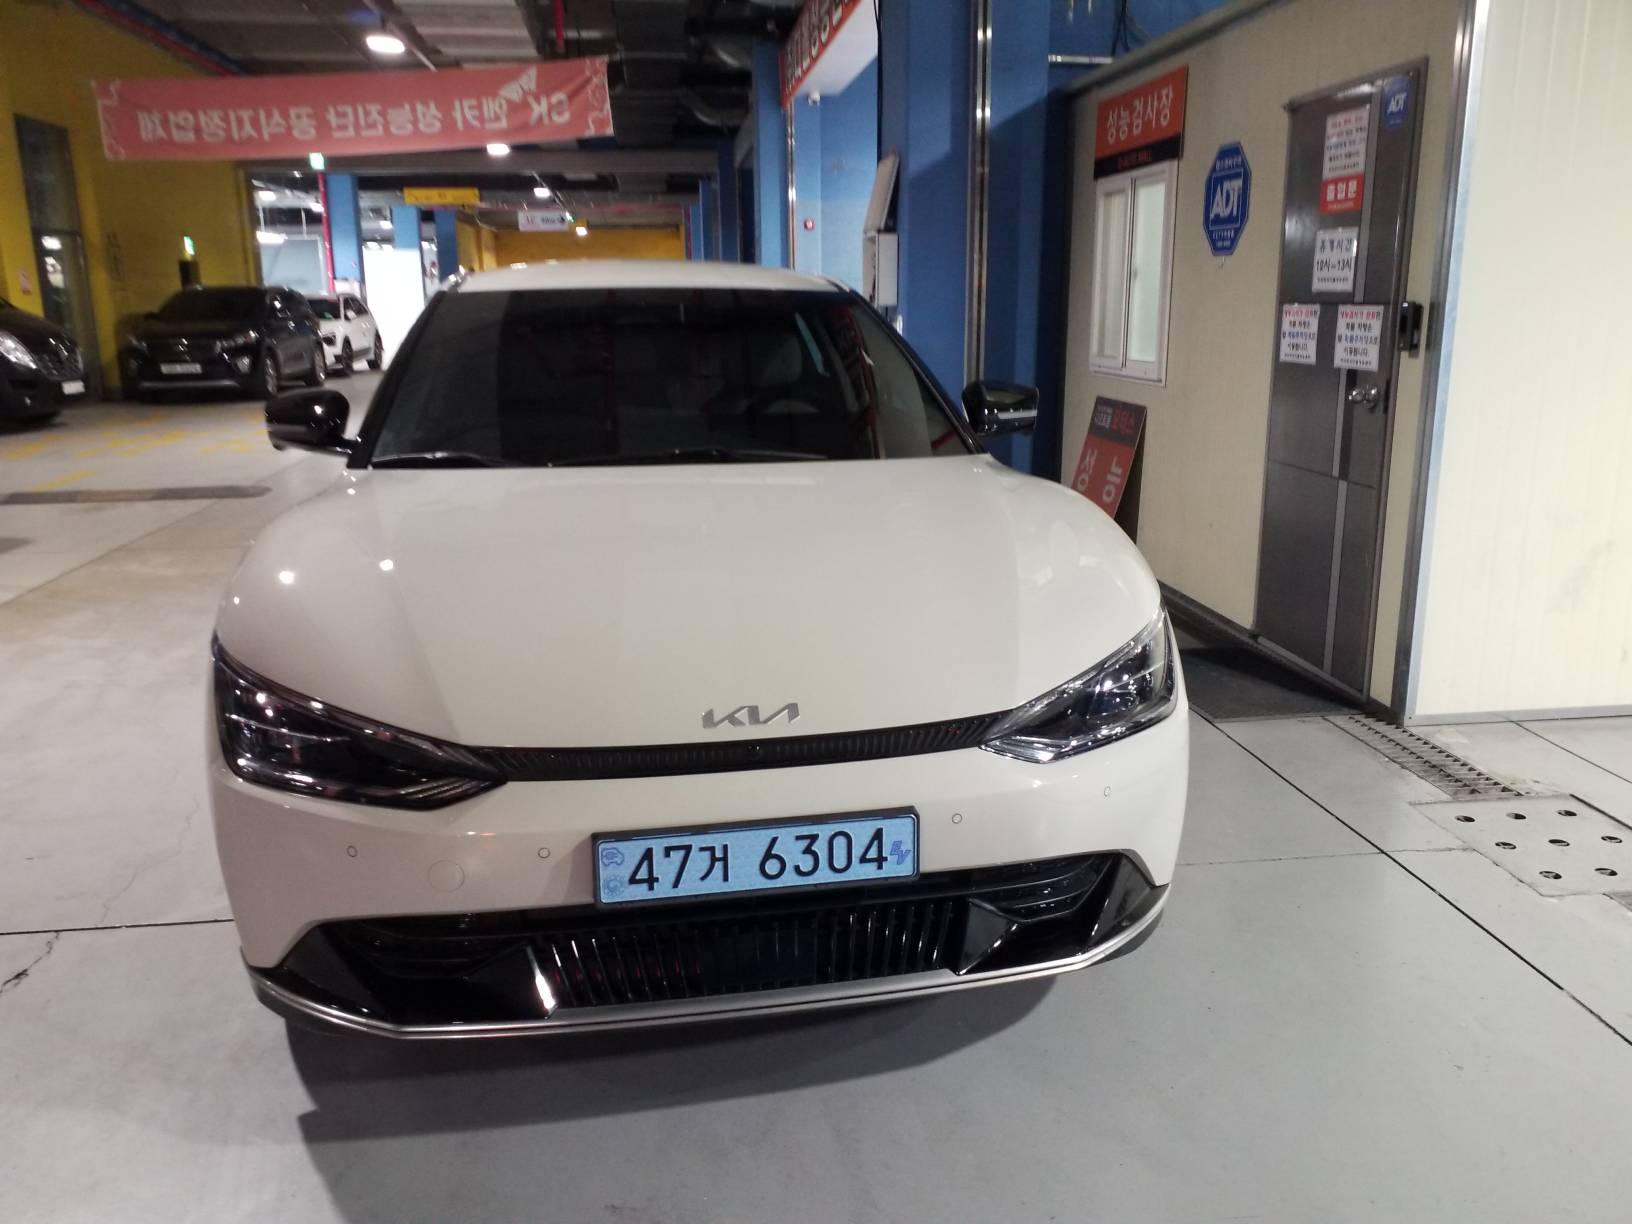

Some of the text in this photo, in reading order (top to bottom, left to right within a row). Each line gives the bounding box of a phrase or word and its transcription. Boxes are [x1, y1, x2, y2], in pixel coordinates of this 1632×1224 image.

[1107, 83, 1174, 145] 성능검사장
[1387, 92, 1408, 114] ADT
[1210, 178, 1243, 218] ADT
[702, 702, 800, 729] KIA
[628, 827, 888, 891] 47거 6304
[889, 840, 911, 866] EV
